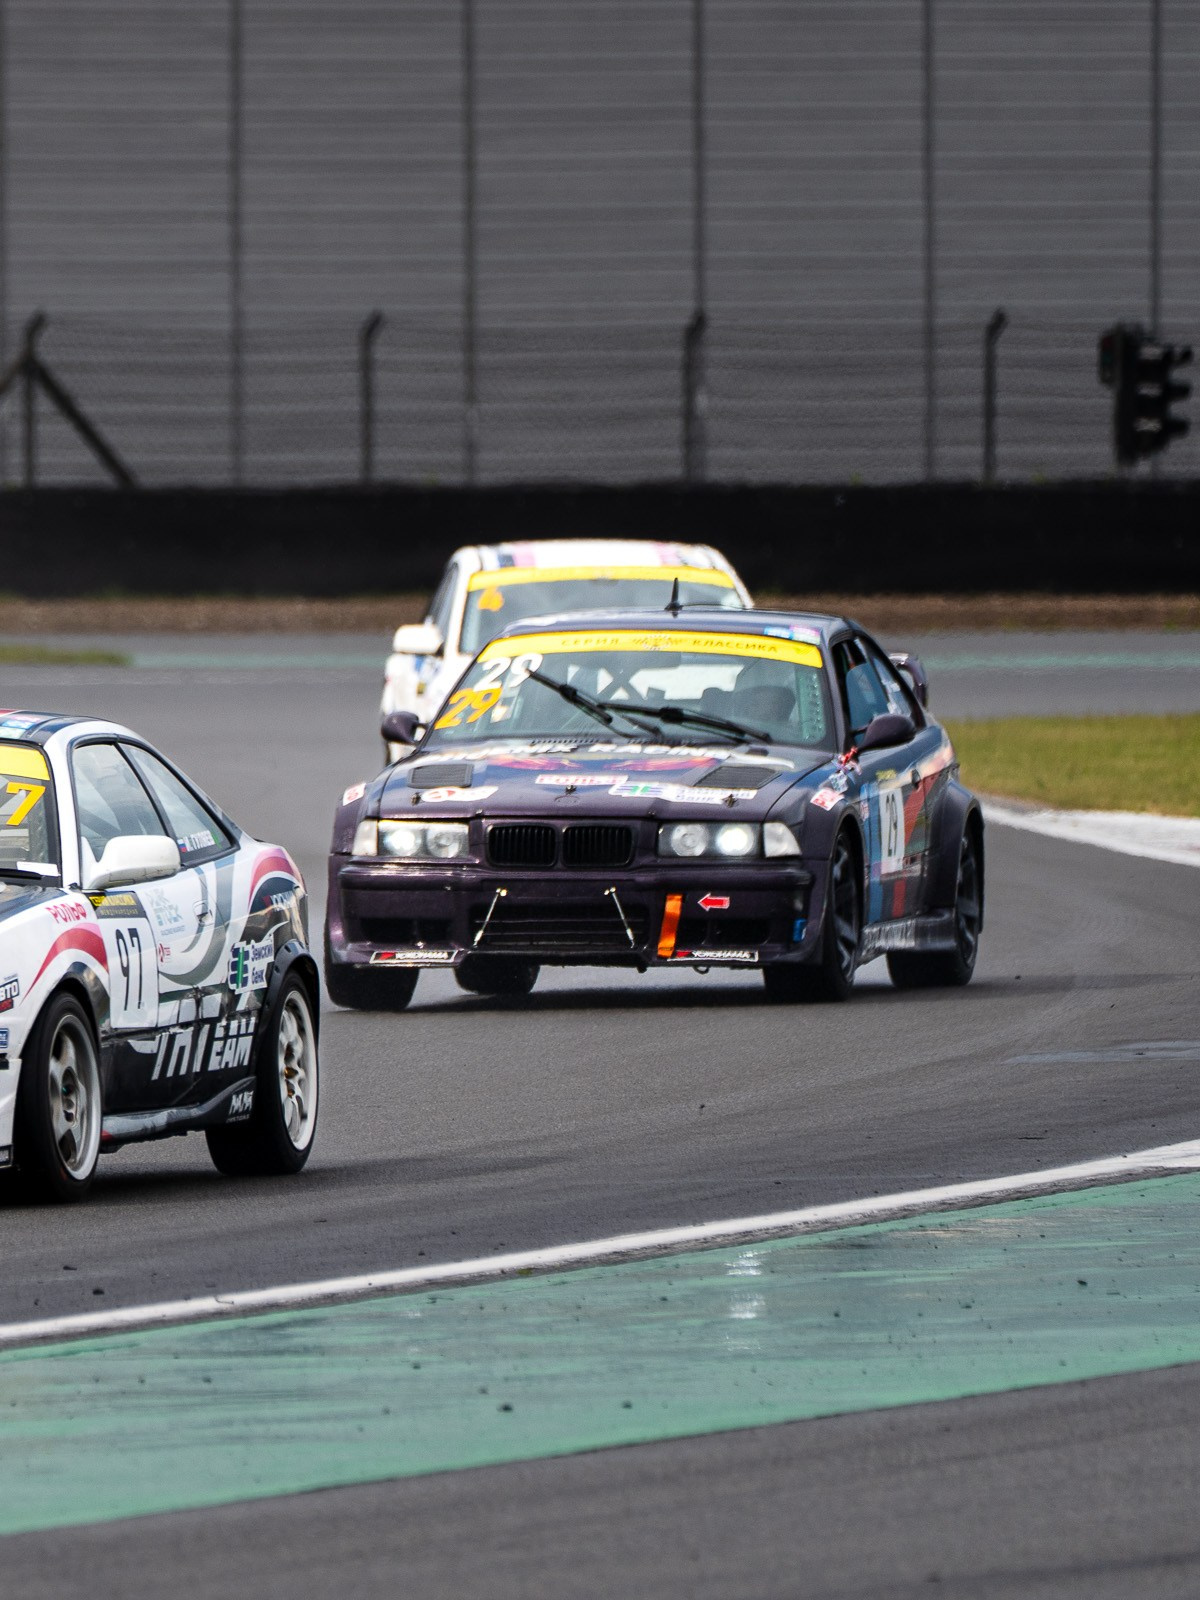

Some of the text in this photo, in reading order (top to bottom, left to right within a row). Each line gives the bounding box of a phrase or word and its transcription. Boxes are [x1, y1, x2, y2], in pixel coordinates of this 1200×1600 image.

[692, 638, 779, 653] КЛАССИКА
[473, 652, 544, 692] 29
[433, 686, 503, 730] 29
[45, 901, 87, 924] РОЛЬФ
[115, 926, 143, 1012] 97
